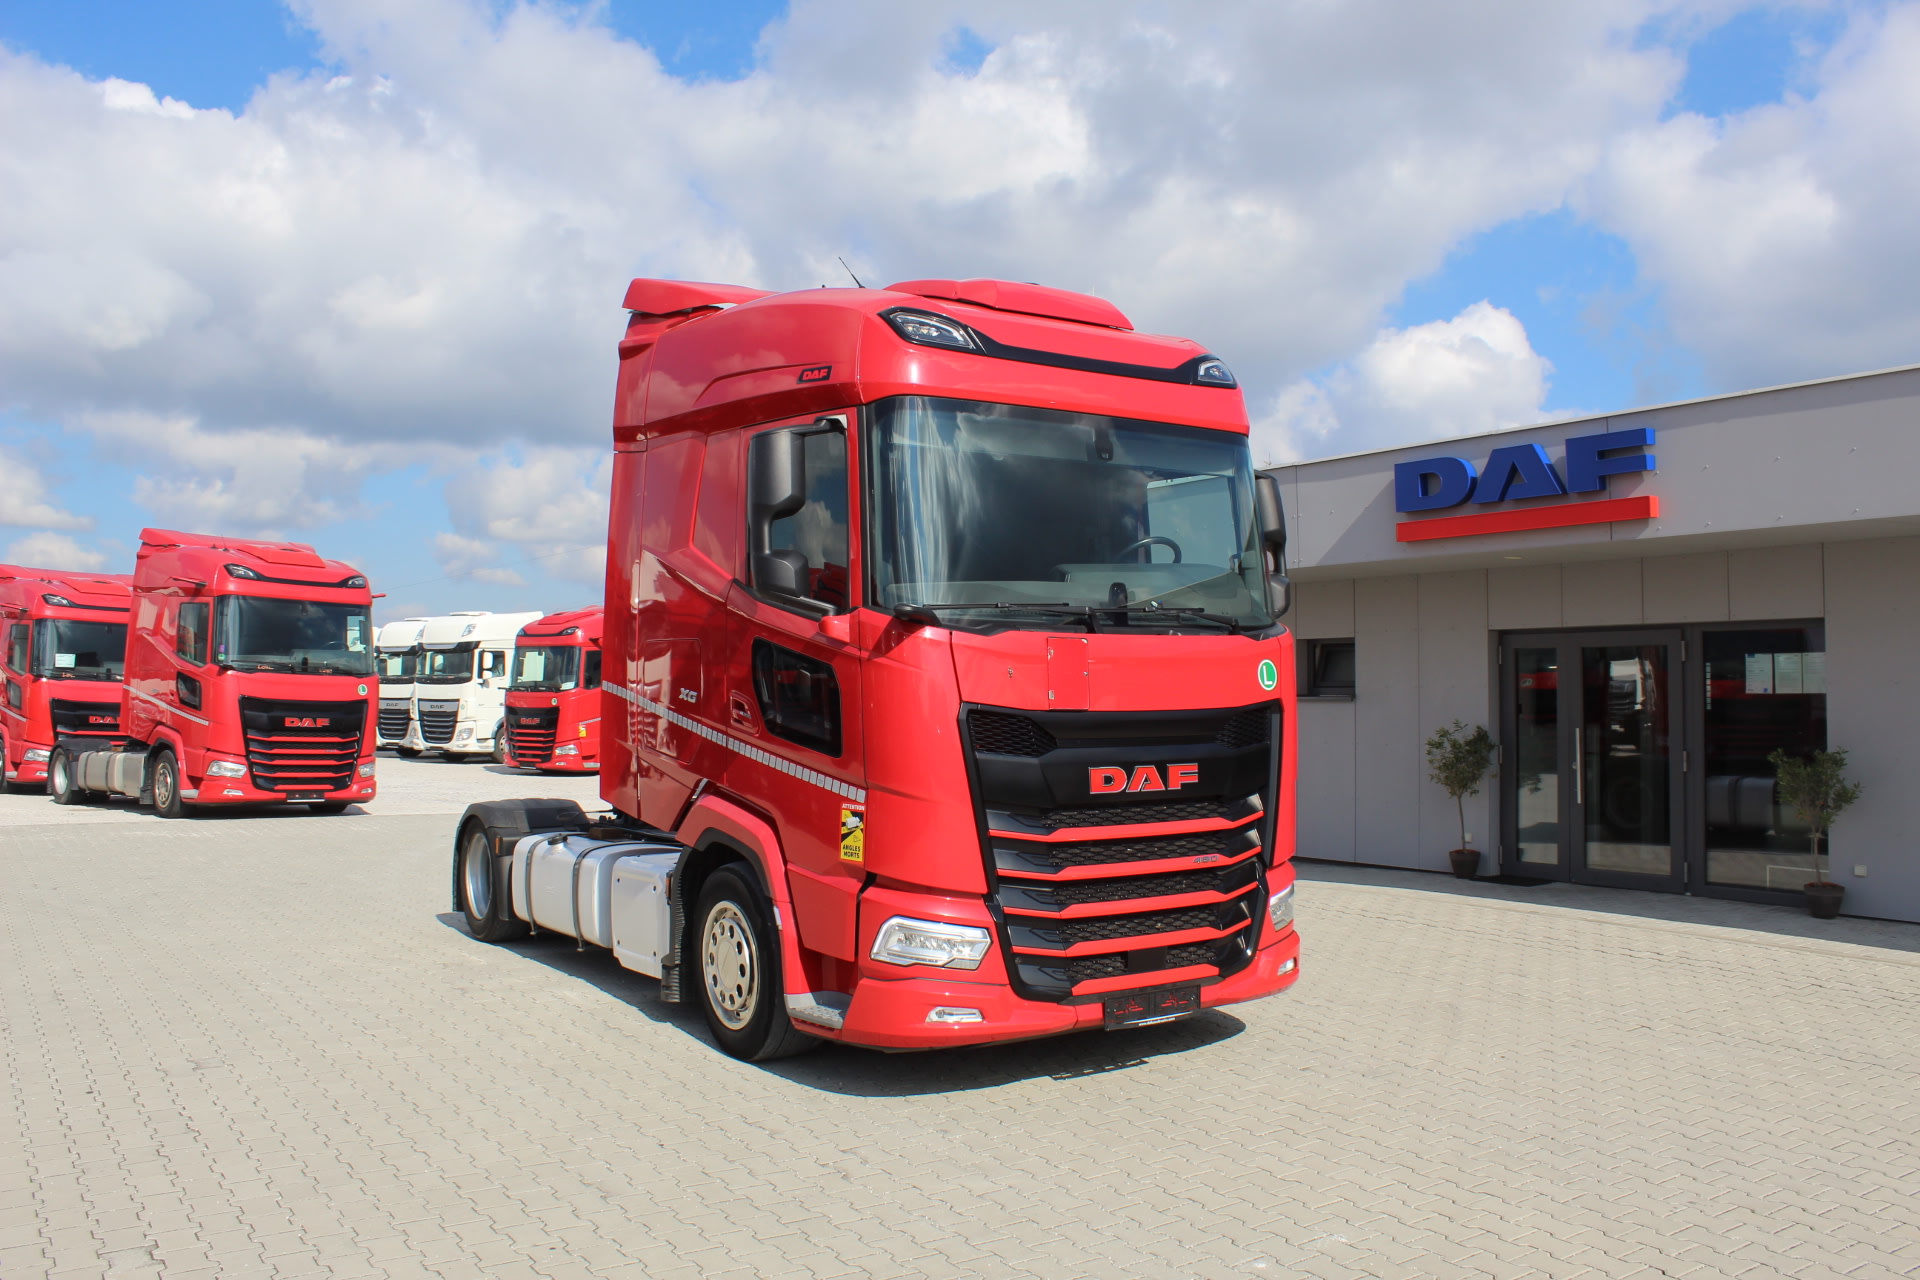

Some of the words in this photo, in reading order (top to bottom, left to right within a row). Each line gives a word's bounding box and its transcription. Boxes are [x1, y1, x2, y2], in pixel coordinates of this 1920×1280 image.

[803, 369, 828, 380] DAF
[1395, 428, 1655, 512] DAF
[1263, 665, 1273, 685] L
[679, 688, 697, 703] XG
[285, 717, 330, 727] DAF
[1088, 763, 1198, 794] DAF
[843, 844, 860, 852] ANGLES
